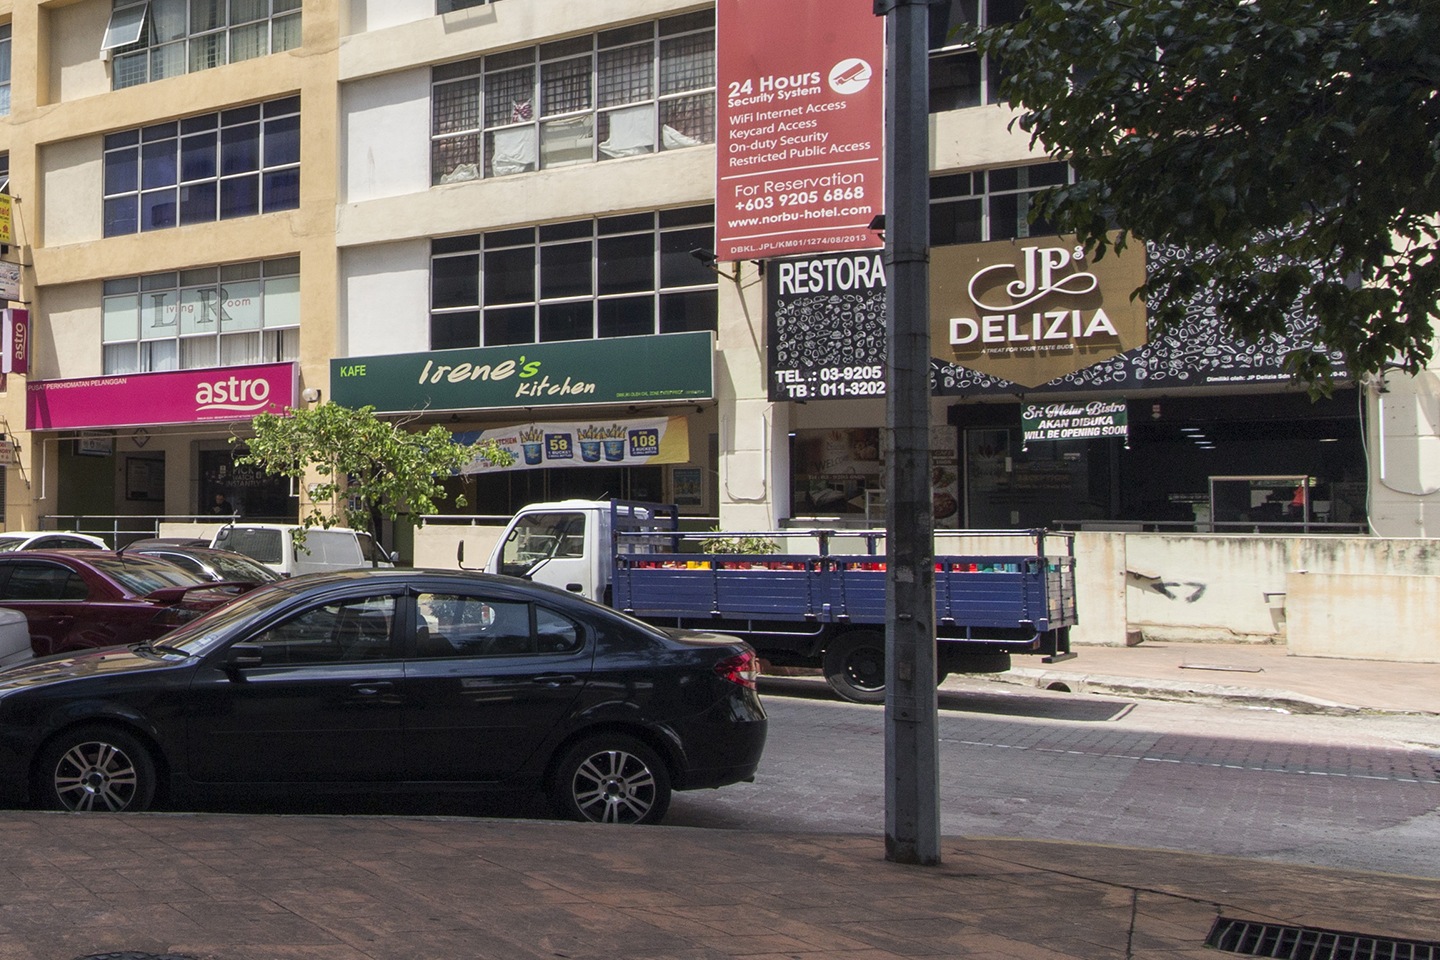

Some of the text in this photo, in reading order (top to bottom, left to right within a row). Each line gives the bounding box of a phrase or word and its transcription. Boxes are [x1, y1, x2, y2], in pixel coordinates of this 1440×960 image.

[728, 71, 821, 99] 24 Hours
[728, 85, 821, 108] Security System
[730, 101, 847, 125] WiFi Internet Access
[730, 119, 818, 140] Keycard Access
[729, 132, 829, 154] On-duty Security
[730, 141, 871, 167] Restricted Public Access
[735, 172, 864, 198] For Reservation
[735, 187, 865, 212] +603 9205 6868
[728, 203, 872, 228] www.norbu-hotel.com
[949, 308, 1118, 345] DELIZIA
[14, 322, 26, 360] astro
[340, 364, 367, 378] KAFE
[418, 355, 542, 385] Irene's
[820, 365, 882, 381] 03-9205
[28, 378, 127, 391] PUSAT PERKHIDMATAN PELANGGAN
[195, 376, 270, 405] astro
[786, 384, 808, 398] TB
[820, 381, 886, 397] 011-3202
[1022, 405, 1045, 420] Sri
[1086, 401, 1126, 416] Bistro
[1024, 425, 1128, 440] WILL BE OPENING SOON
[1038, 416, 1114, 430] AKAN DIBUKA
[549, 439, 568, 451] 58
[631, 434, 657, 448] 108
